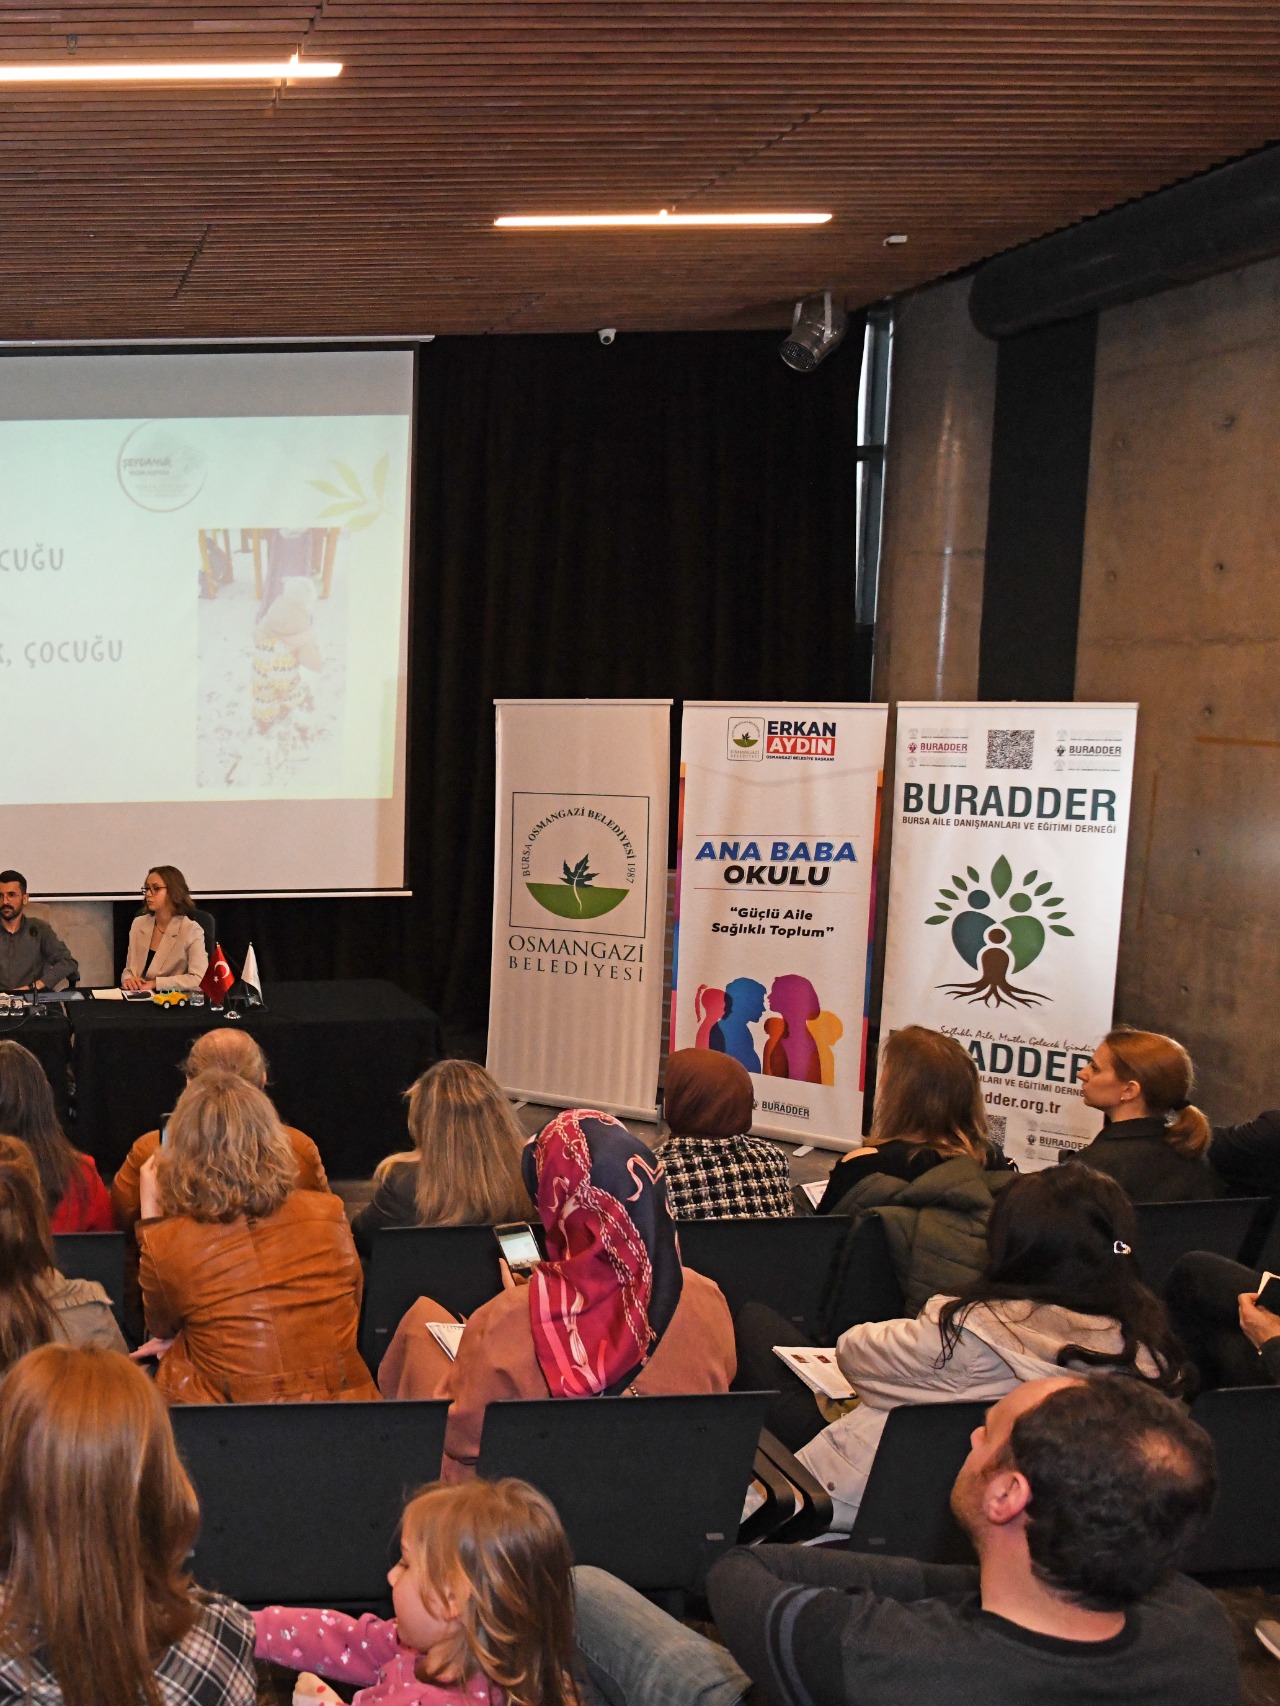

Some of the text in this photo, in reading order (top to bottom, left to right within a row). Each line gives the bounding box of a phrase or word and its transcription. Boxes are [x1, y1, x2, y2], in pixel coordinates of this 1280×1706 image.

[23, 634, 124, 669] ÇOCUĞU
[767, 720, 836, 737] ERKAN
[768, 737, 833, 755] AYDIN
[920, 742, 968, 752] BURADDER
[1069, 745, 1122, 755] BURADDER
[903, 782, 1116, 822] BURADDER
[902, 816, 930, 825] BURSA
[932, 817, 951, 826] AİLE
[953, 818, 1020, 830] DANIŞMANLARI
[1023, 821, 1035, 830] VE
[522, 806, 637, 884] BURSA OSMANGAZİ BELEDİYESİ 1987
[694, 841, 858, 863] ANA BABA
[723, 865, 831, 887] OKULU
[783, 909, 813, 921] Aile
[711, 922, 766, 936] Sağlıklı
[508, 934, 644, 963] OSMANGAZİ
[508, 955, 643, 982] BELEDİYESİ
[969, 1040, 1093, 1085] ADDER
[1005, 1078, 1016, 1087] VE
[1055, 1086, 1085, 1097] DERNE
[762, 1101, 810, 1117] BURADDER
